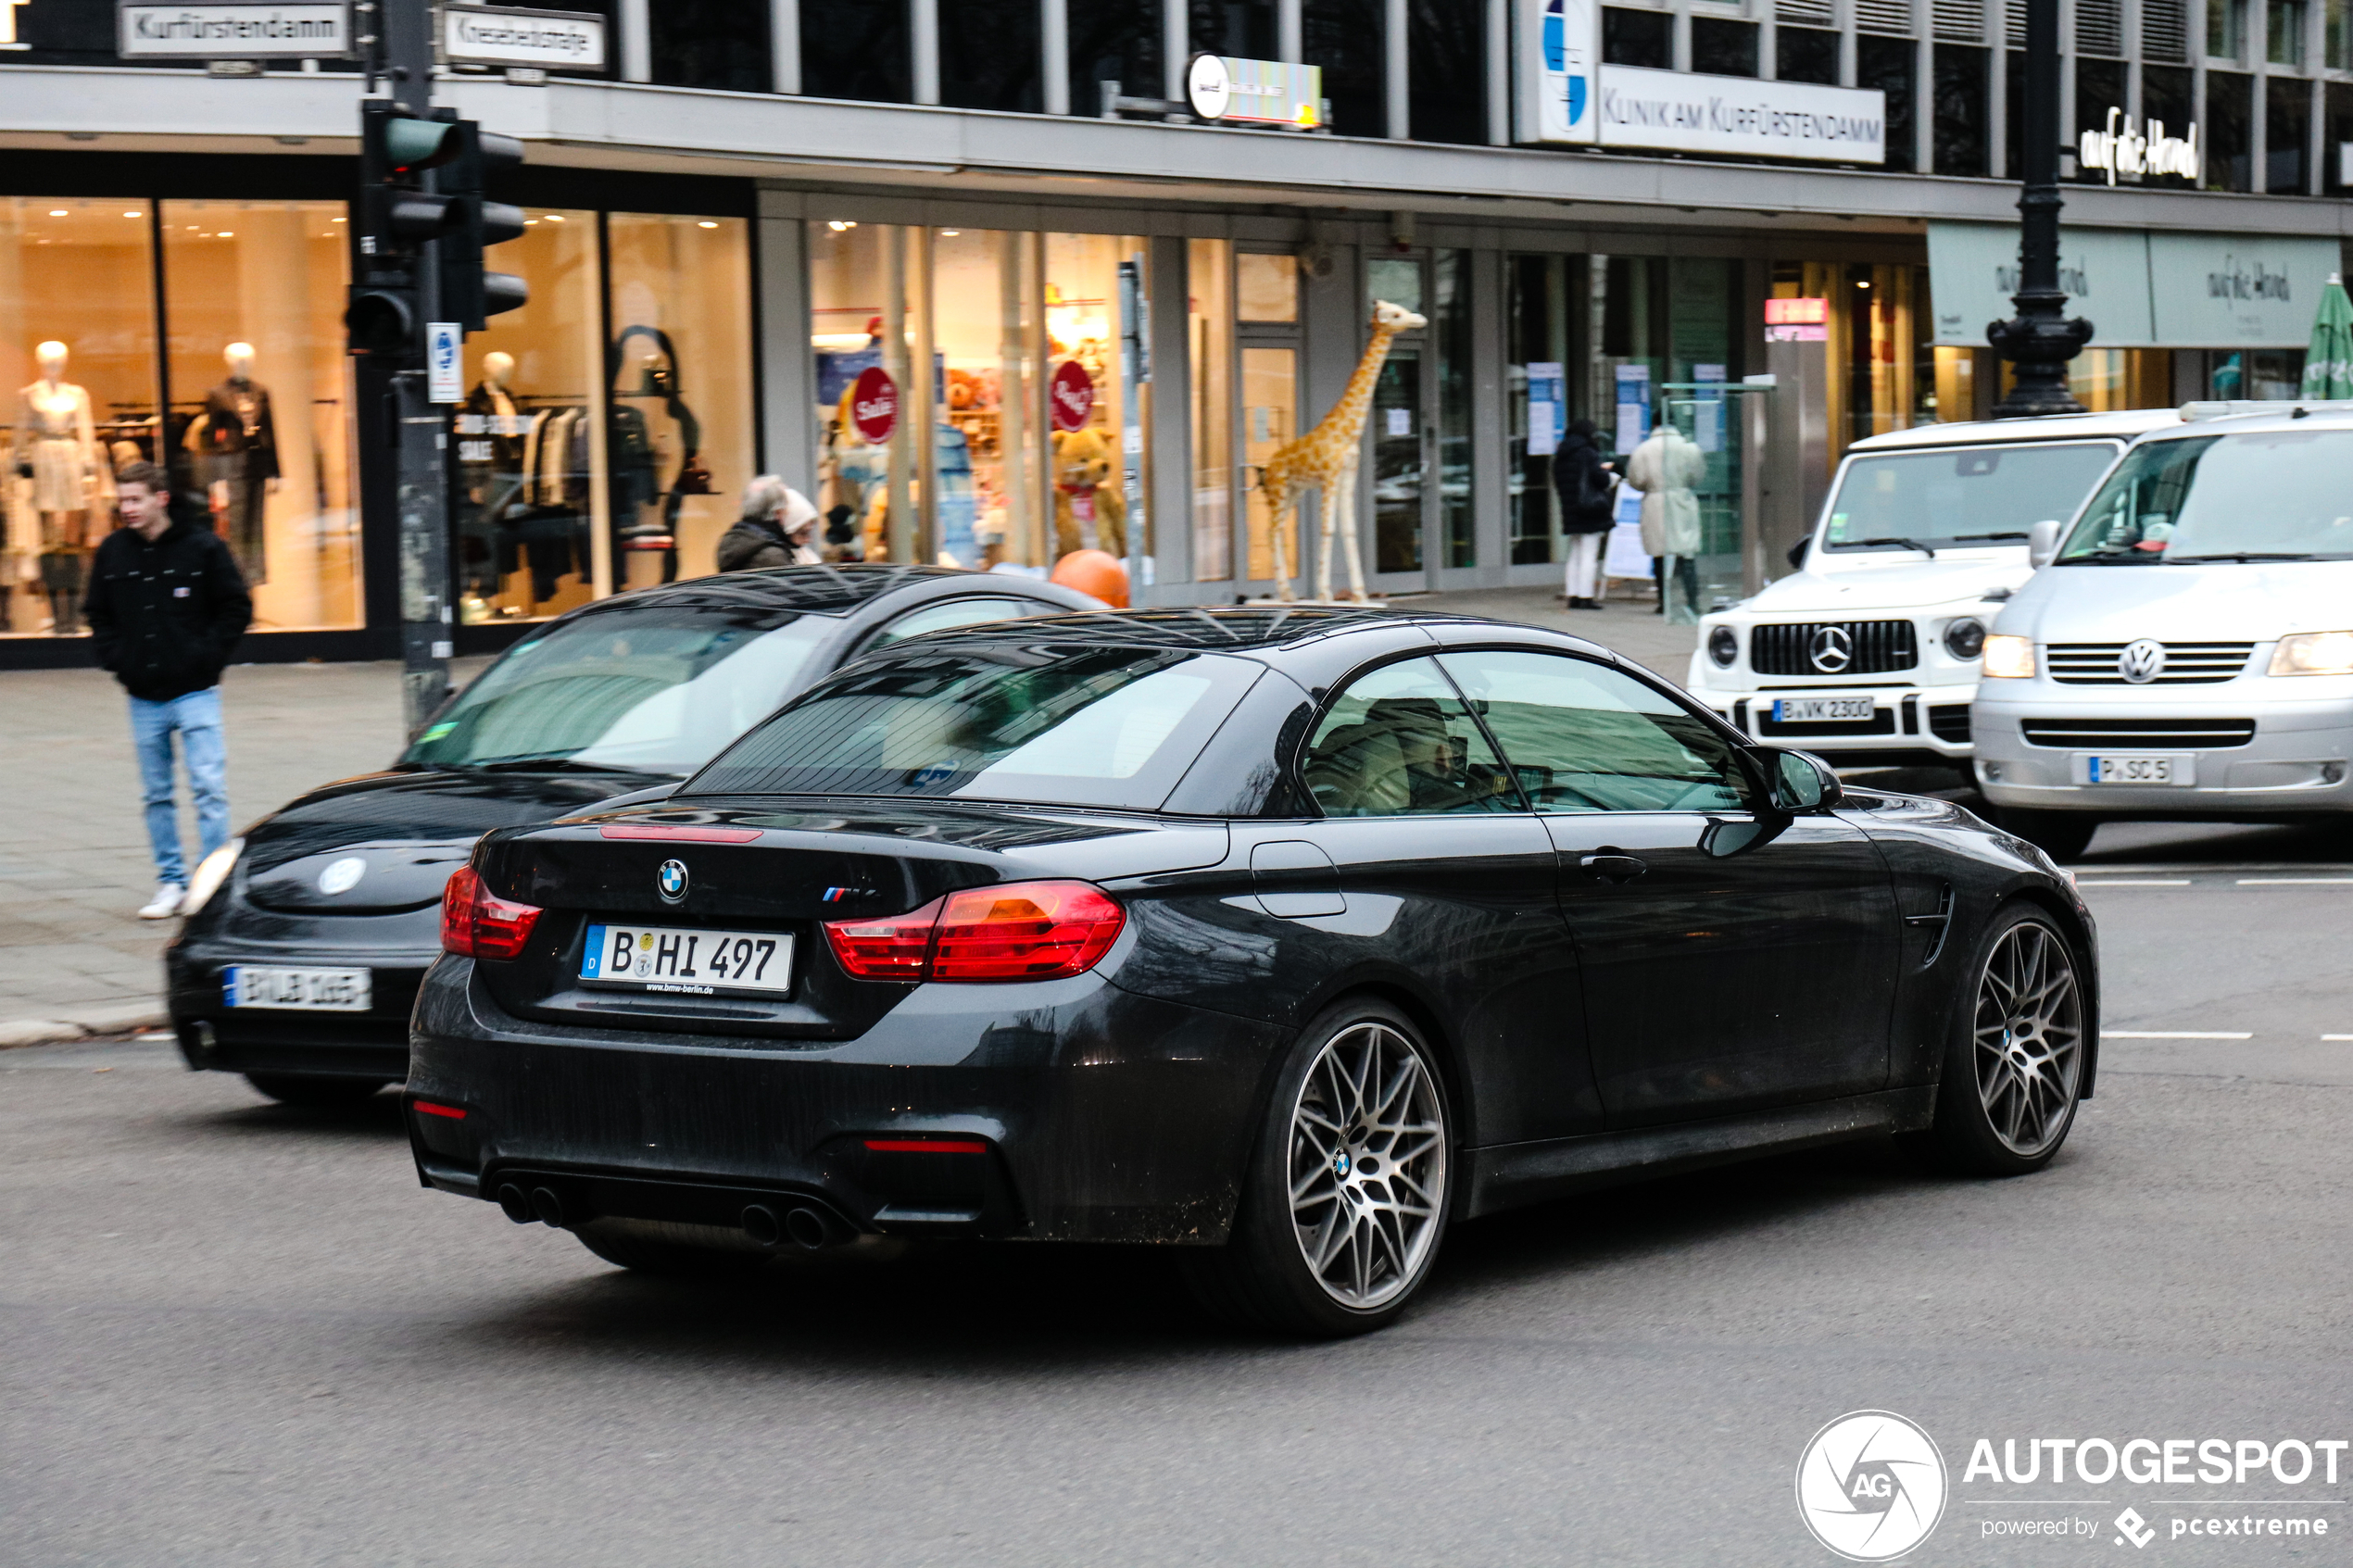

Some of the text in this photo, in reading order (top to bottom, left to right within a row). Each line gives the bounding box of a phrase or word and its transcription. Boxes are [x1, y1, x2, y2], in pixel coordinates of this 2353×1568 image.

[133, 12, 334, 39] Kurfürstendamm
[1603, 87, 1881, 144] KLINIK AM KURFÜRSTENDAMM
[1782, 701, 1793, 718] B
[1830, 700, 1869, 717] 2300
[2102, 760, 2114, 779] P
[2155, 760, 2168, 779] 5
[660, 861, 685, 873] BMW
[587, 958, 597, 970] D
[611, 931, 776, 980] B HI 497
[646, 983, 713, 995] www.bmw-berlin.de
